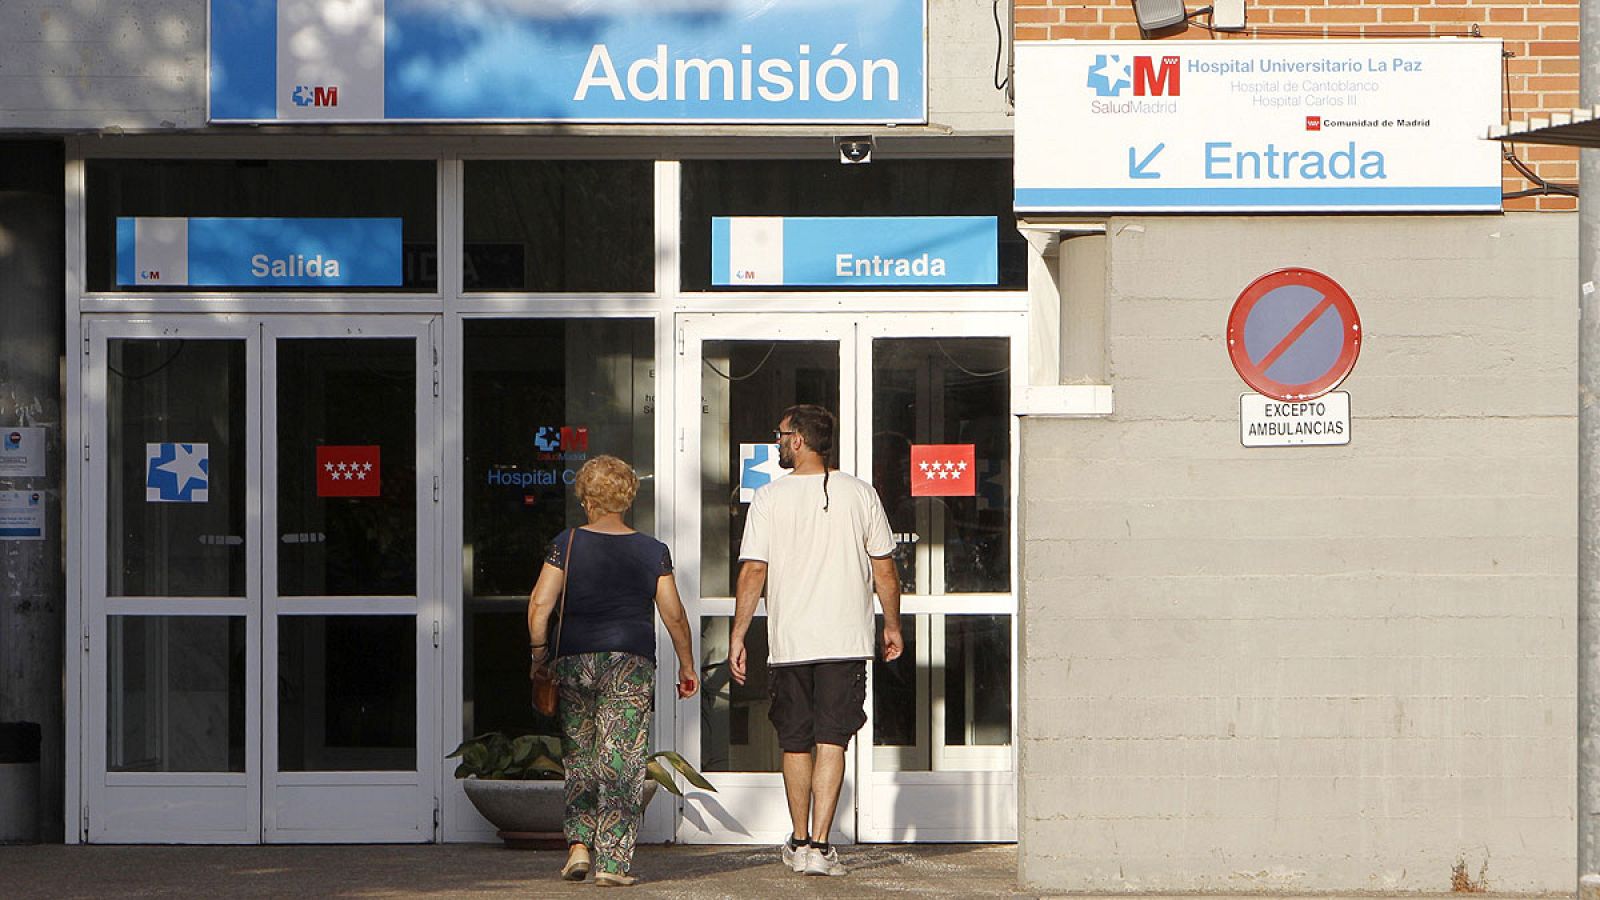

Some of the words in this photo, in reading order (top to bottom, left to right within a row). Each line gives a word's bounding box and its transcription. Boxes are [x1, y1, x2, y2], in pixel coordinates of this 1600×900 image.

[572, 41, 899, 101] Admisión
[1187, 59, 1254, 75] Hospital
[1259, 58, 1363, 73] Universitario
[1368, 58, 1388, 72] La
[1393, 58, 1423, 72] Paz
[1230, 80, 1281, 93] Hospital
[1283, 80, 1299, 91] de
[1302, 80, 1379, 92] Cantoblanco
[1091, 100, 1177, 114] SaludMadrid
[1252, 94, 1302, 107] Hospital
[1305, 94, 1344, 106] Carlos
[1347, 94, 1357, 106] III
[1323, 119, 1379, 128] Comunidad
[1382, 119, 1394, 127] de
[1396, 119, 1431, 128] Madrid
[1204, 141, 1387, 179] Entrada
[251, 253, 340, 278] Salida
[835, 253, 946, 277] Entrada
[1264, 402, 1326, 417] EXCEPTO
[1248, 420, 1344, 436] AMBULANCIAS
[487, 468, 557, 488] Hospital
